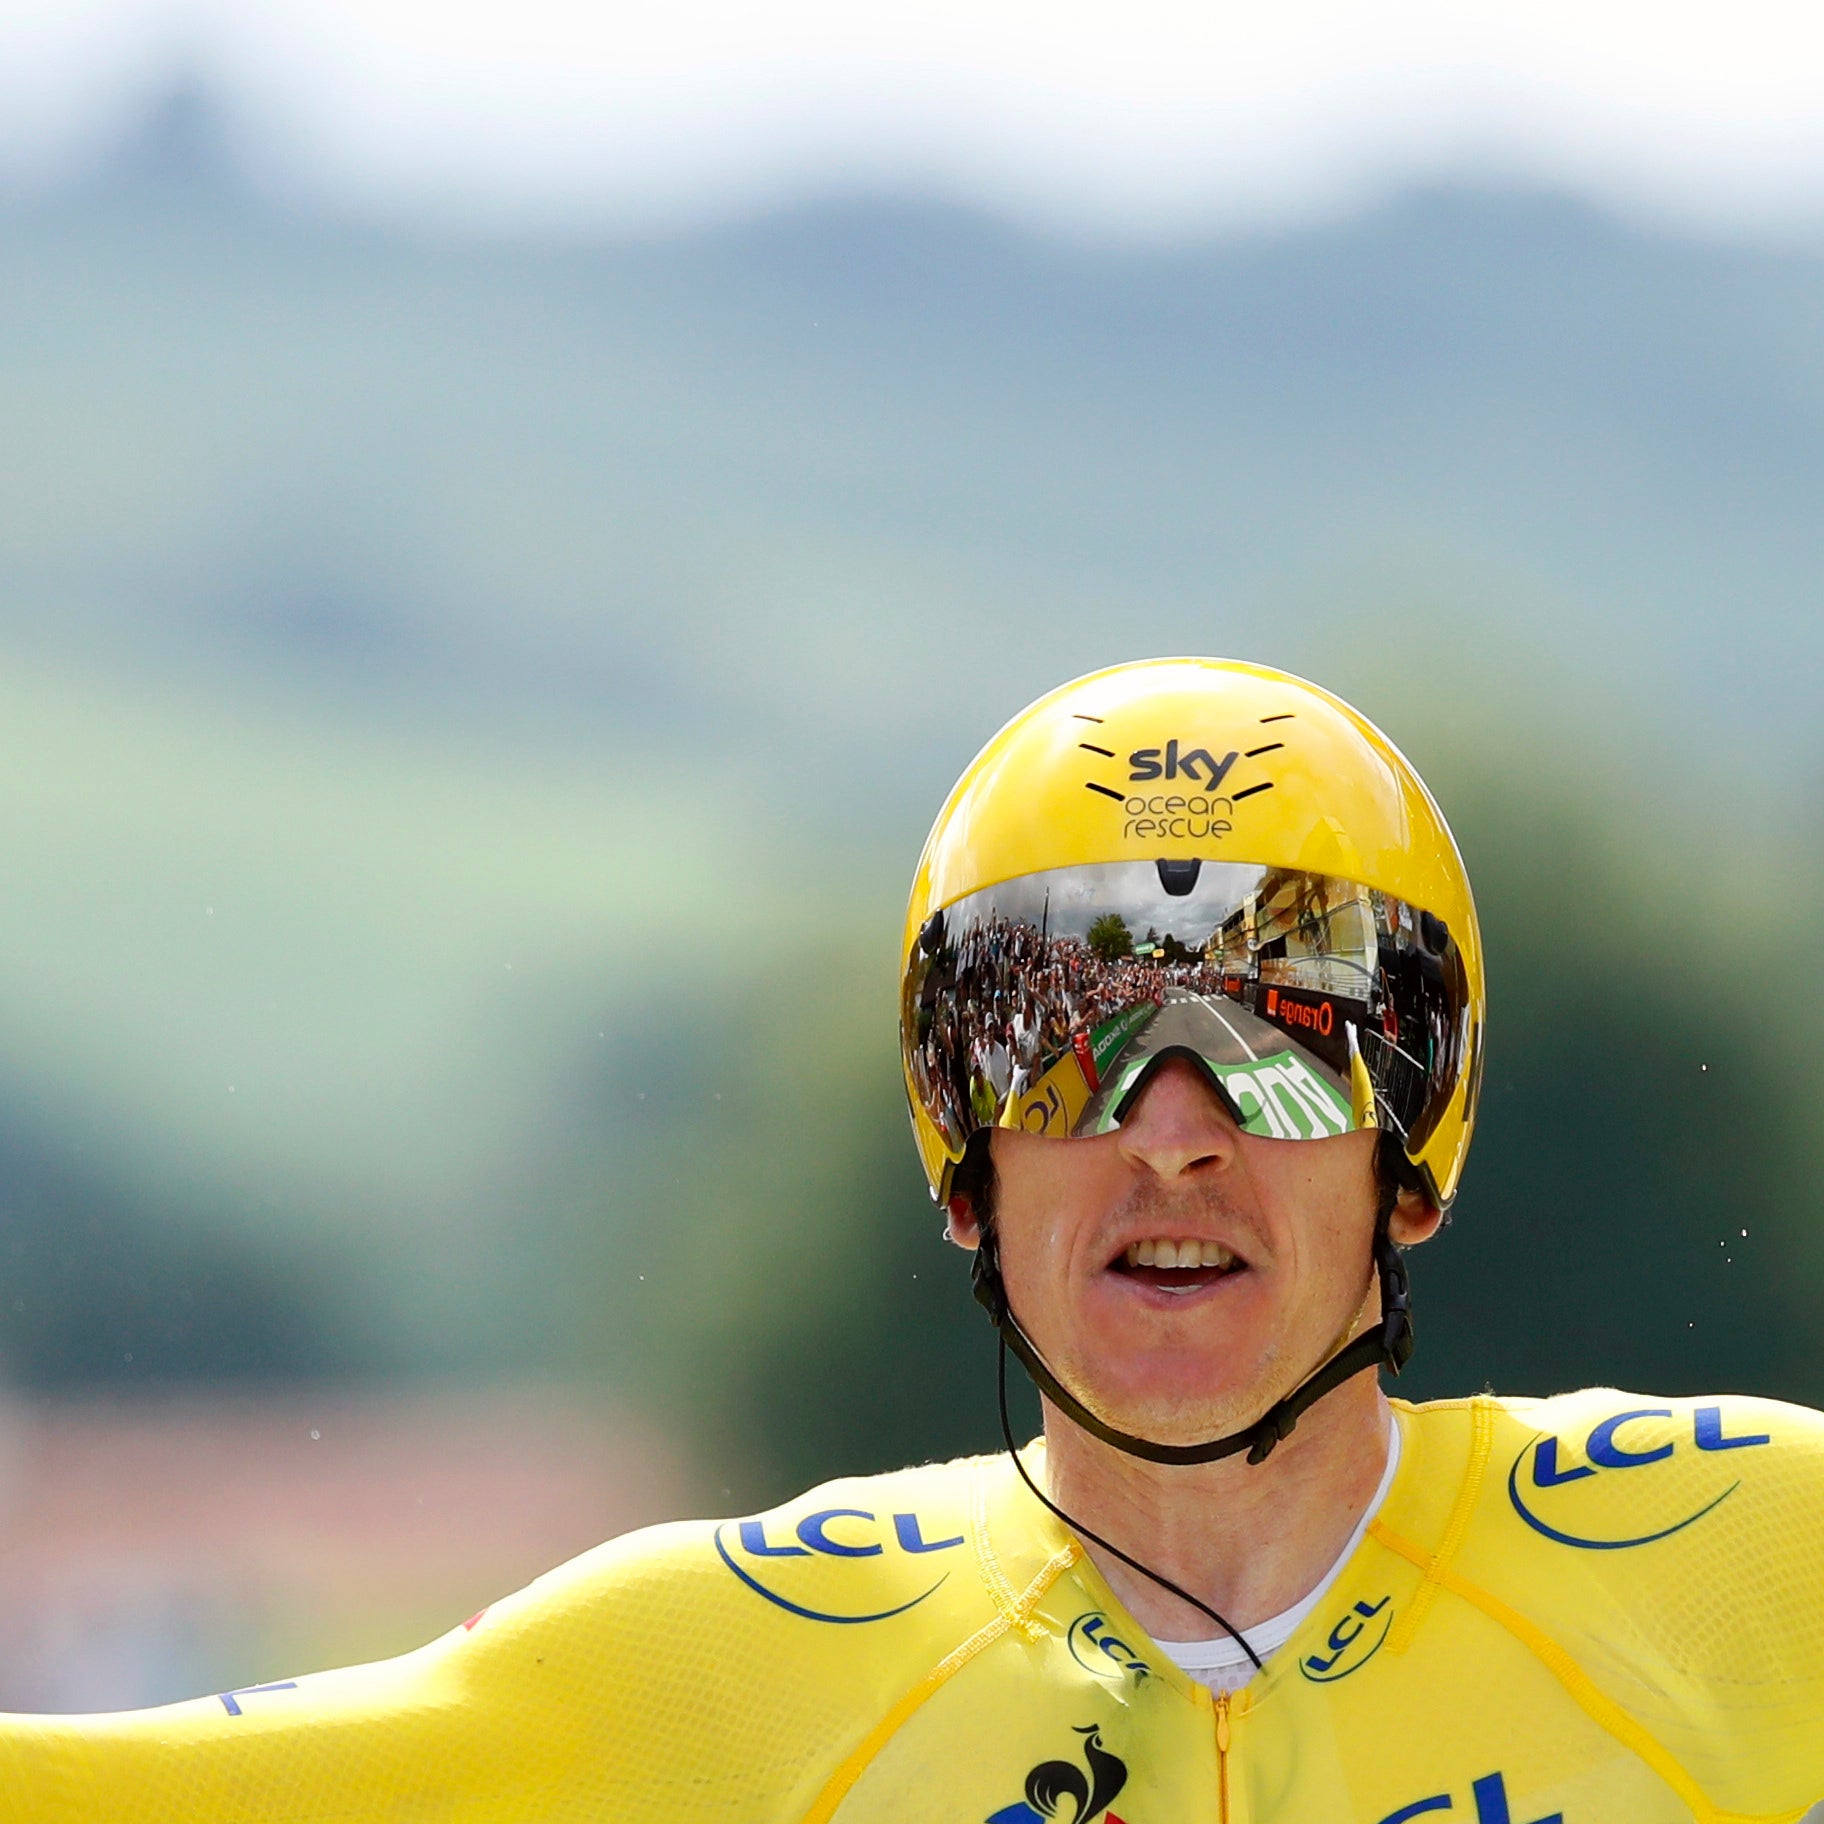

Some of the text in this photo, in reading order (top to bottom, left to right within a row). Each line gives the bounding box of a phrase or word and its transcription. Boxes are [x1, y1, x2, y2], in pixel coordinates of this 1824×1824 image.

[1129, 739, 1239, 791] sky
[1124, 818, 1232, 839] rescue
[1125, 796, 1233, 815] ocean
[1533, 1406, 1770, 1487] LCL
[739, 1509, 965, 1557] LCL
[1306, 1596, 1391, 1672] LCL
